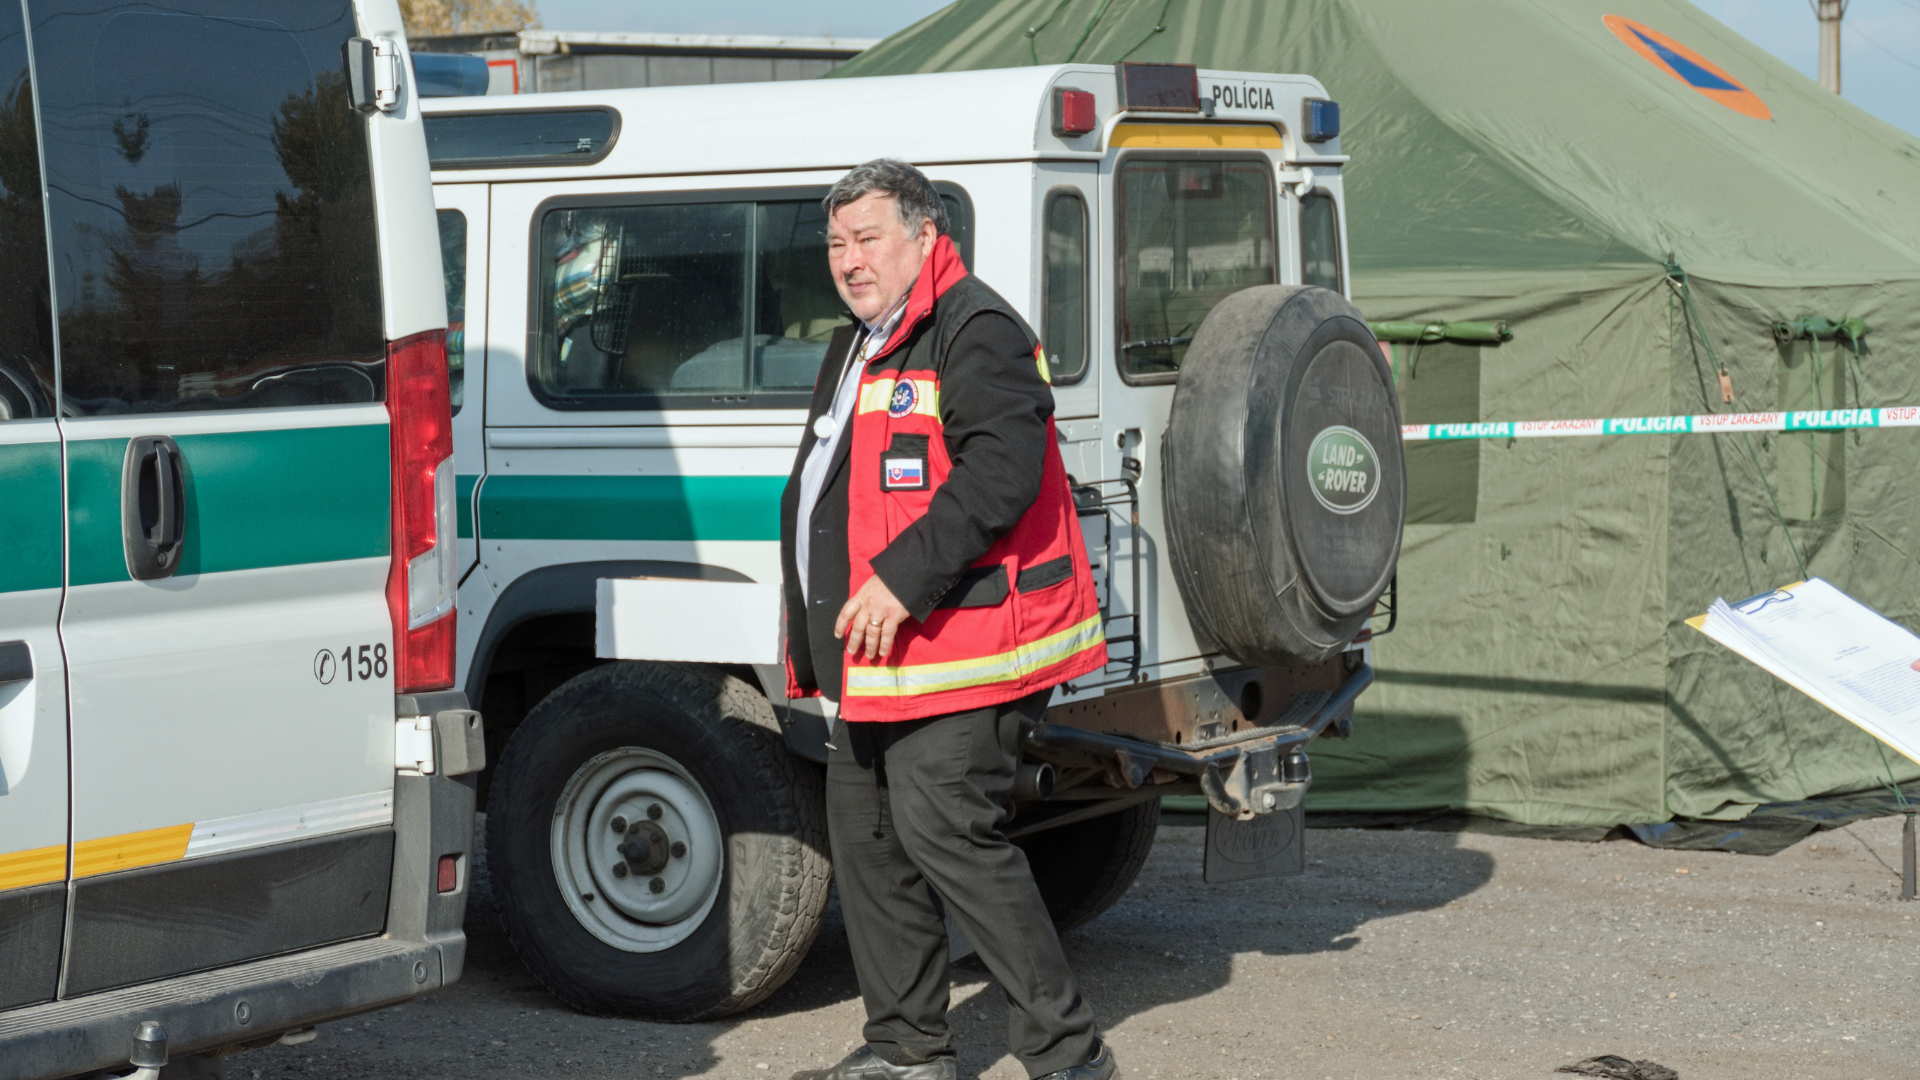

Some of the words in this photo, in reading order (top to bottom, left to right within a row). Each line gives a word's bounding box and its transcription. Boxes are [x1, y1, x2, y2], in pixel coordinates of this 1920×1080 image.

[1212, 81, 1274, 110] POLÍCIA
[1700, 414, 1729, 426] VSTUP
[1886, 407, 1917, 420] VSTUP
[1321, 443, 1357, 467] LAND
[1324, 468, 1368, 493] ROVER
[341, 642, 388, 682] 158
